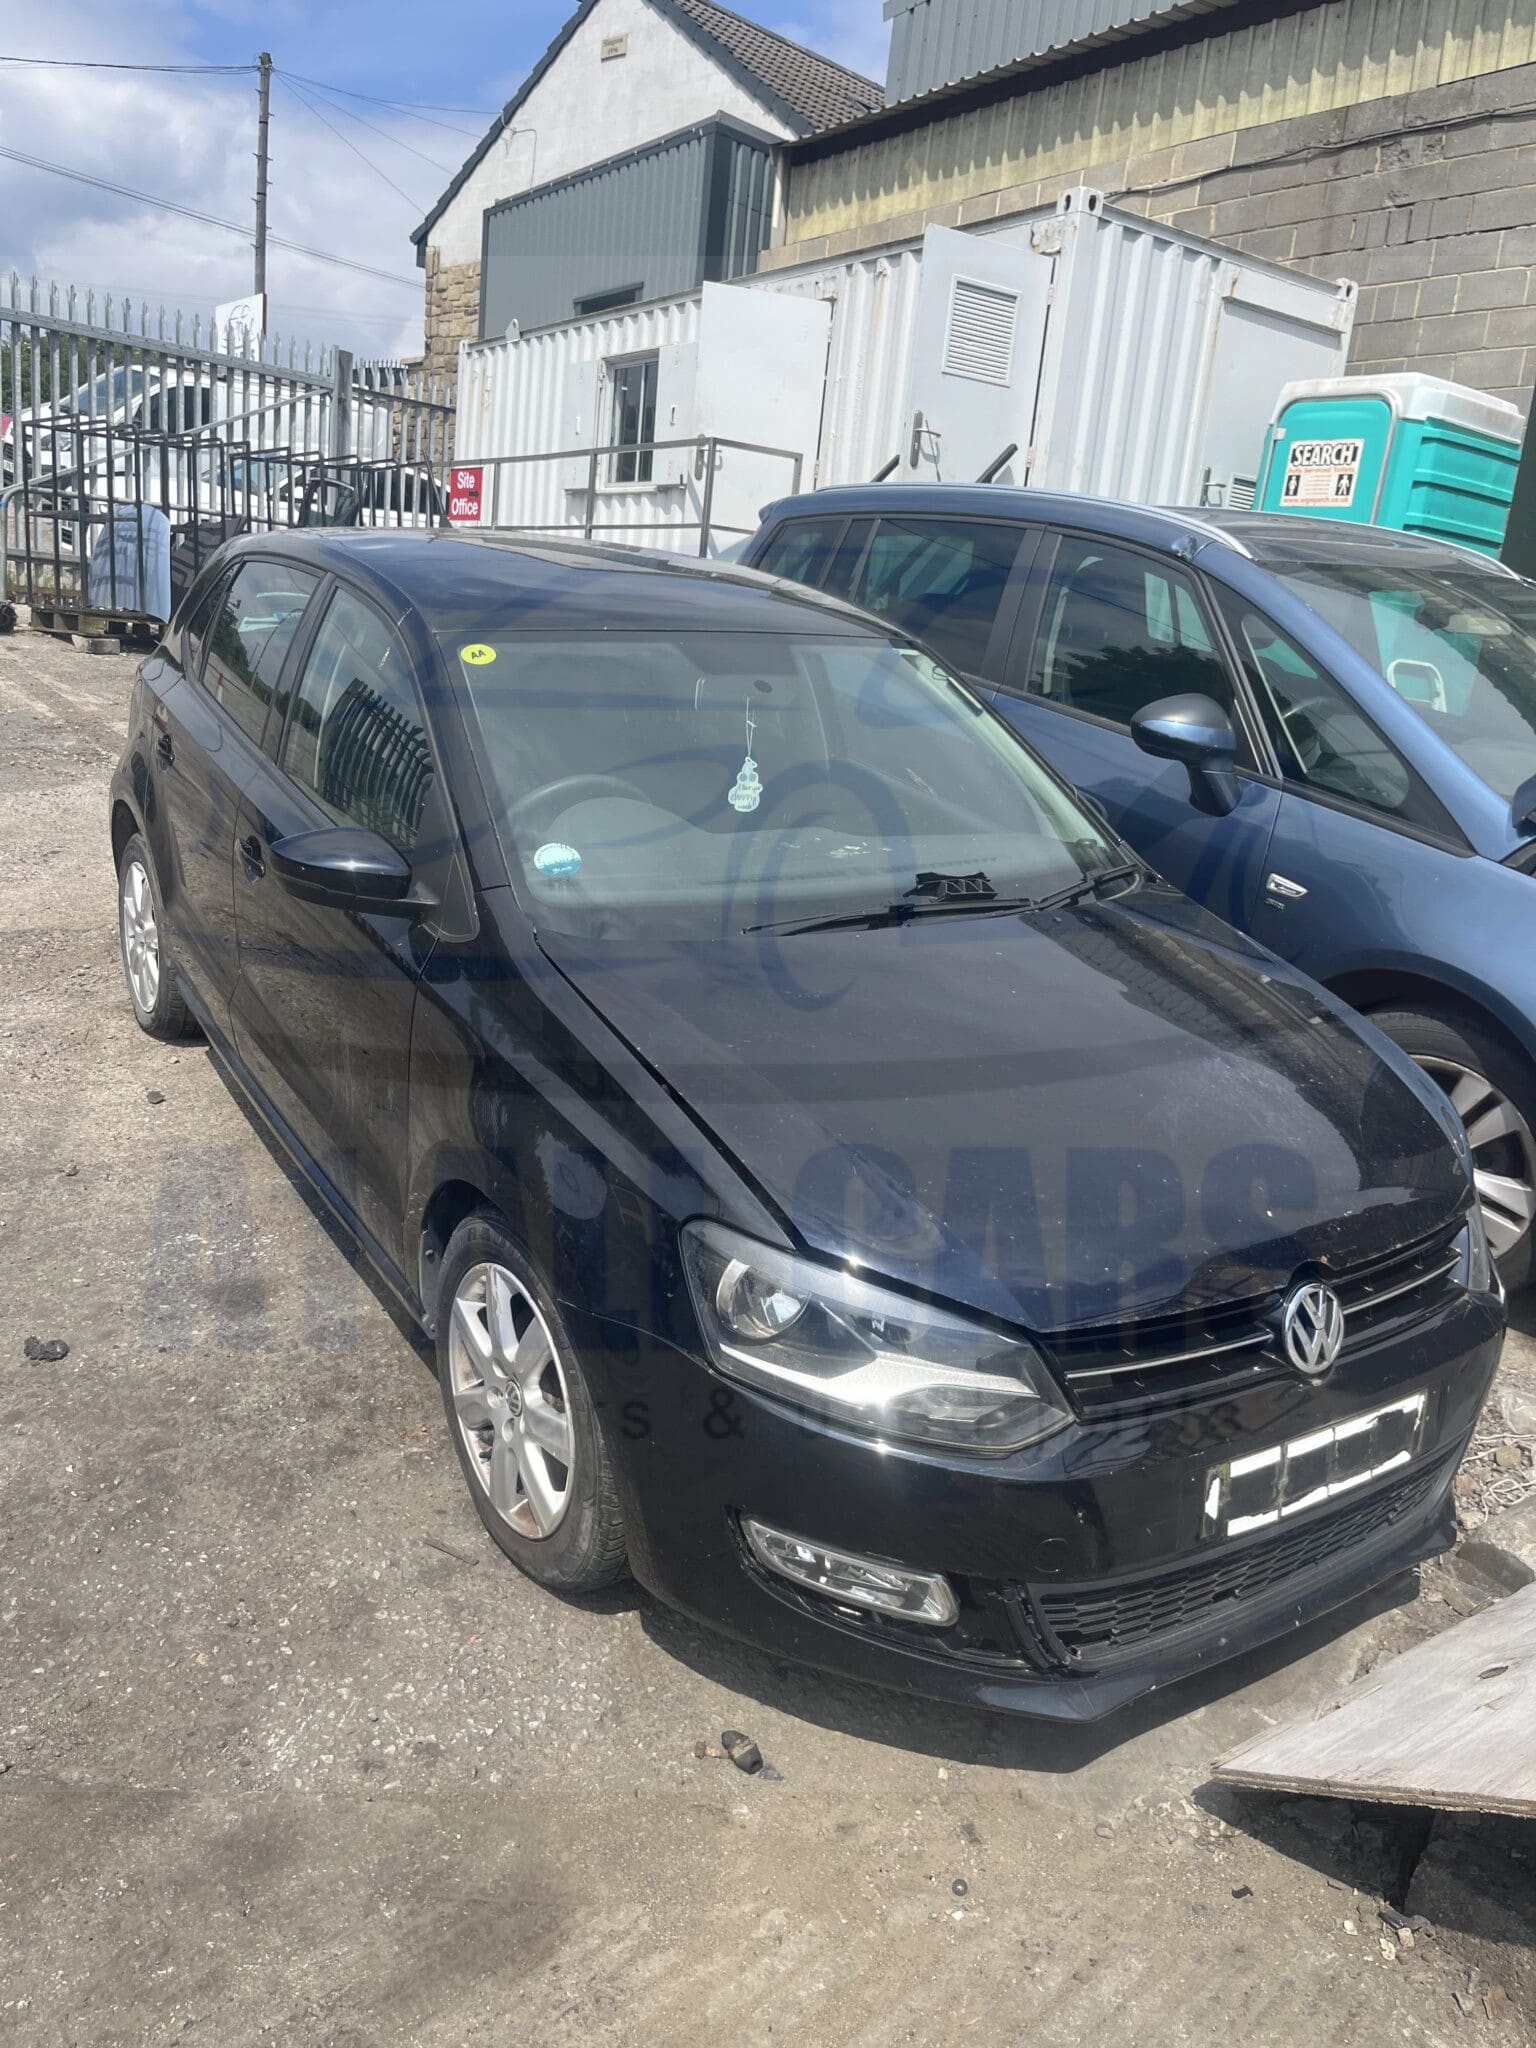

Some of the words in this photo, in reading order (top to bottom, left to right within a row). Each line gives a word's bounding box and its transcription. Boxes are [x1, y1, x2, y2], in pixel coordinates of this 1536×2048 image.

[1292, 442, 1356, 467] SEARCH
[457, 471, 476, 489] Site
[451, 497, 479, 516] Office
